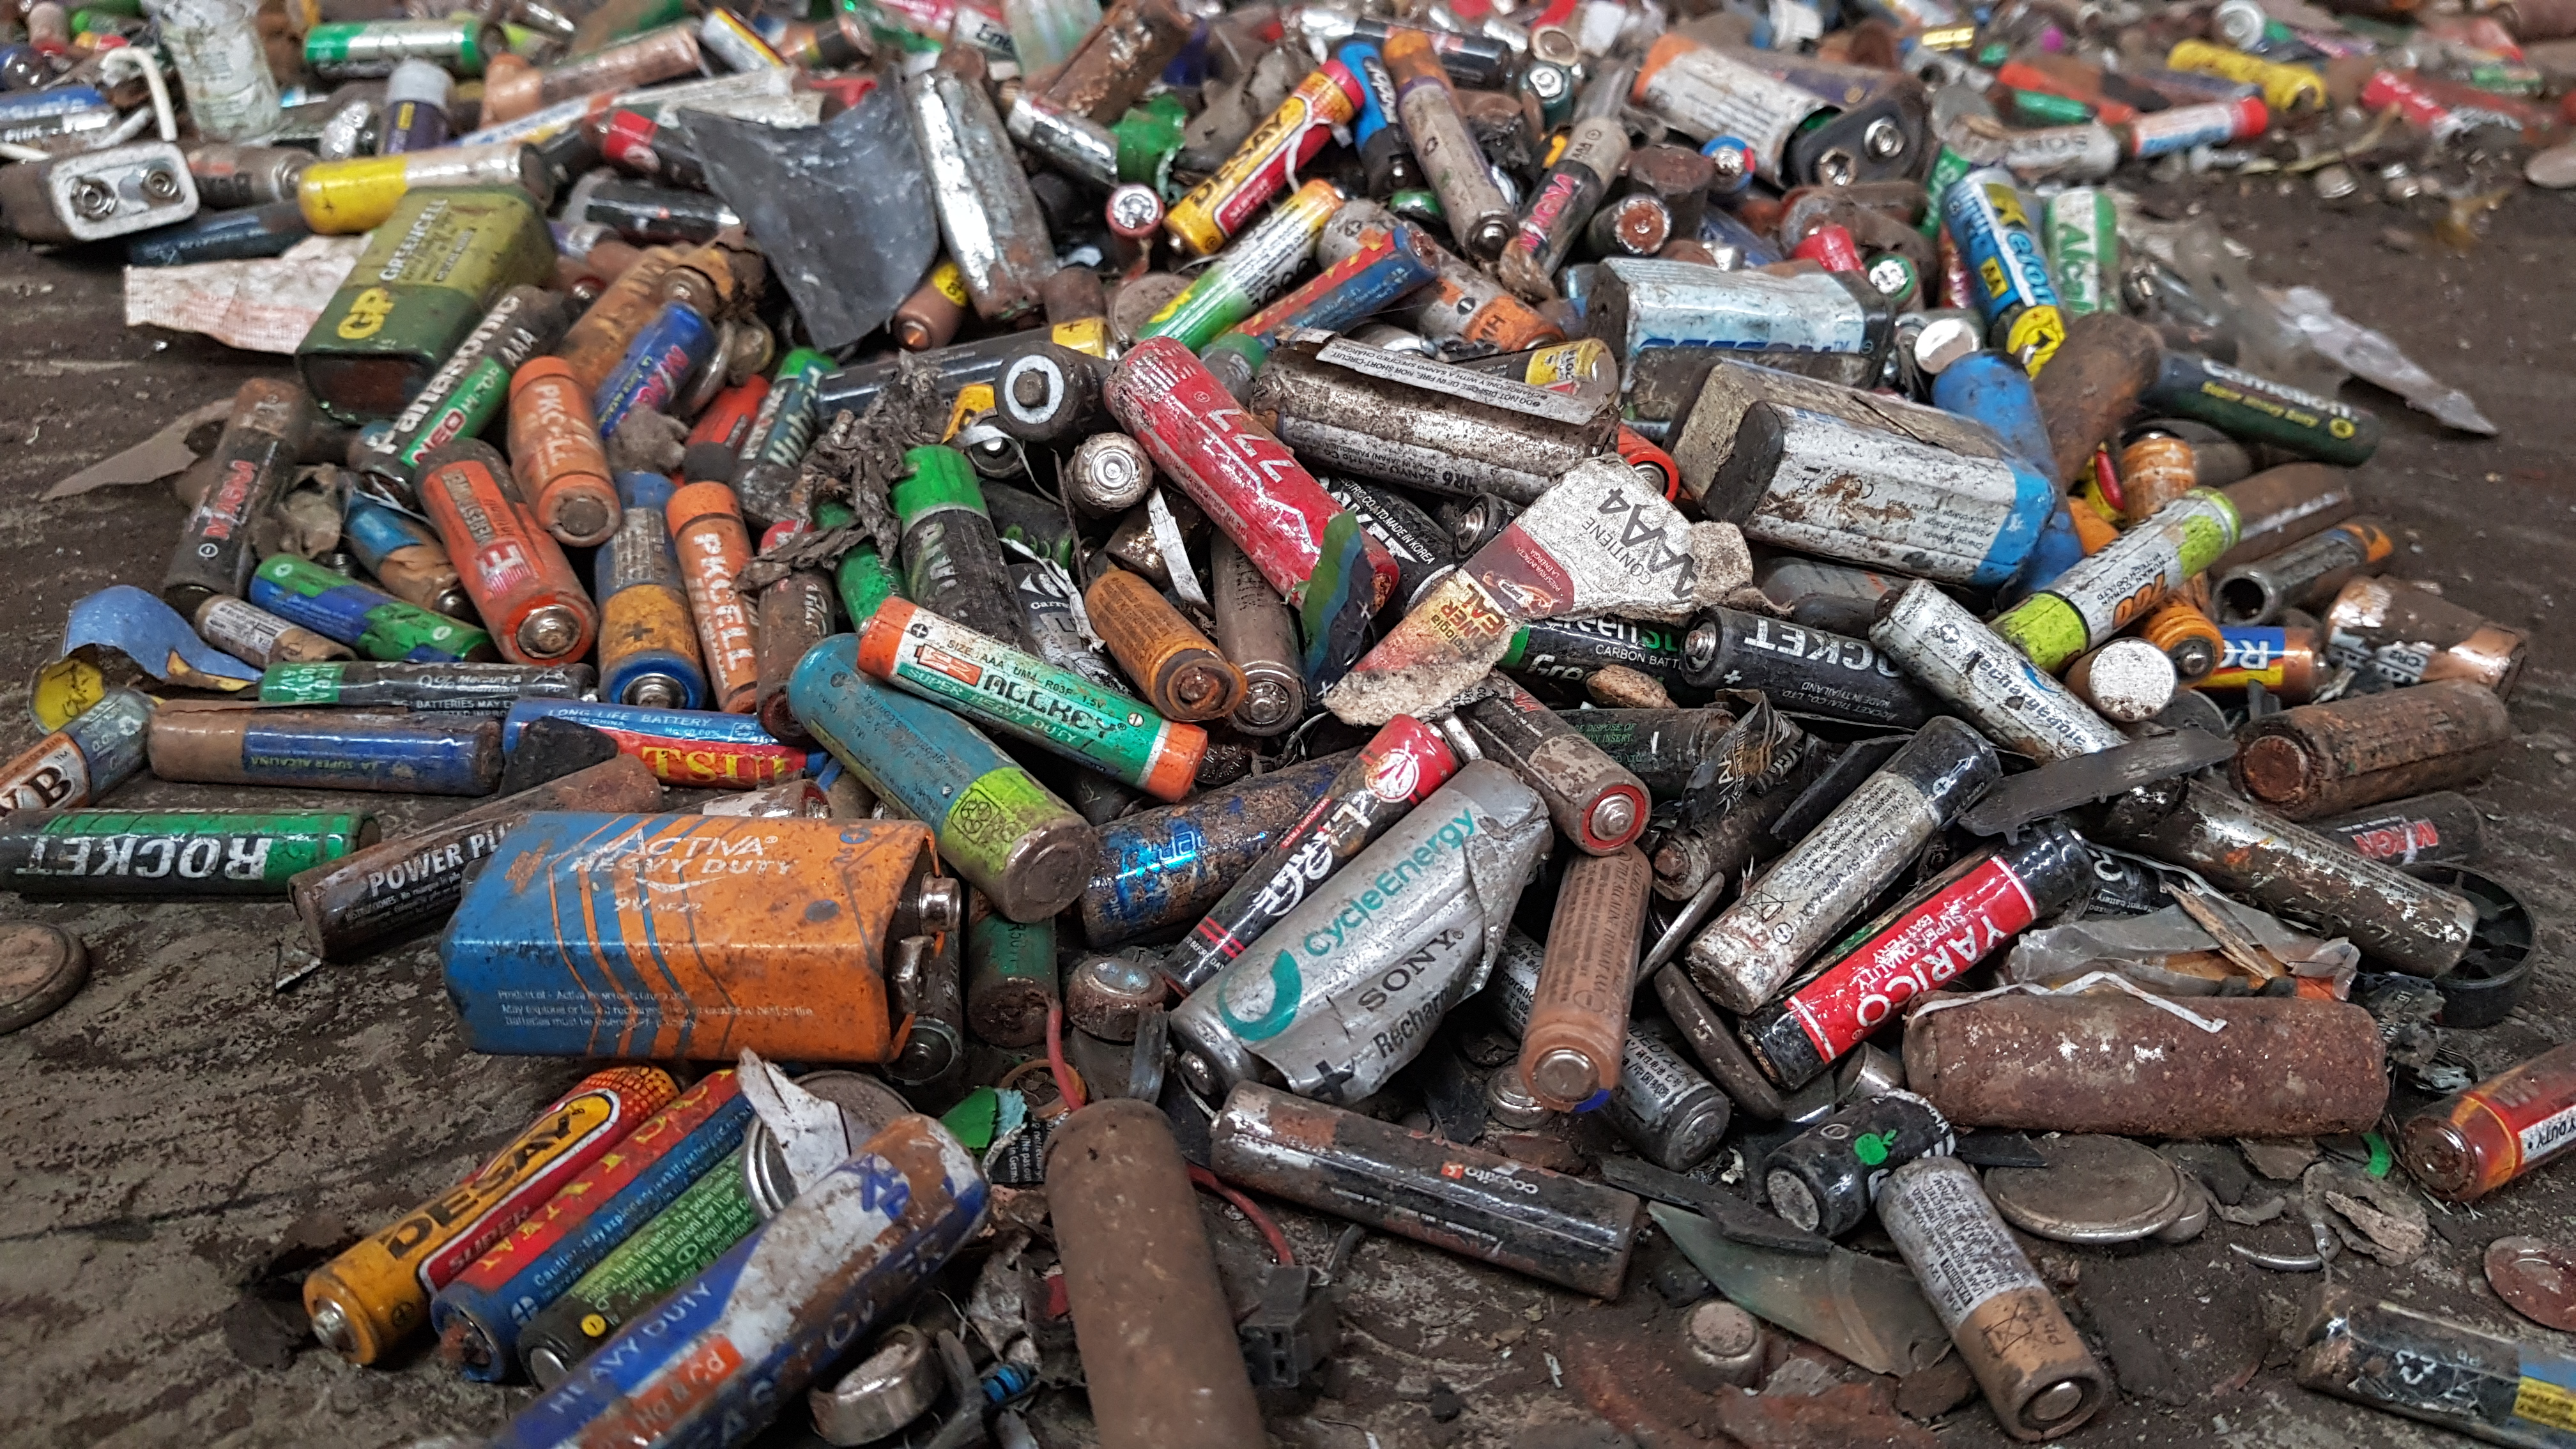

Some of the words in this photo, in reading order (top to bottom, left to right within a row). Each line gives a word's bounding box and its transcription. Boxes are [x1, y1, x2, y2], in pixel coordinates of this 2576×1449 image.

[1394, 366, 1414, 378] NOR
[1416, 362, 1446, 376] SANYO
[1455, 372, 1479, 384] WITH
[1499, 392, 1519, 403] NOT
[1409, 539, 1435, 565] KOREA
[1581, 515, 1654, 587] CONTIENE
[1549, 568, 1560, 579] LA
[946, 639, 974, 657] SIZE
[979, 653, 1006, 670] AAA
[1011, 666, 1038, 683] UM4
[1594, 642, 1646, 664] CARBON
[1648, 653, 1683, 671] BATT
[906, 666, 964, 698] SUPER
[1031, 716, 1078, 744] DUTY
[1800, 681, 1851, 700] THAILAND
[548, 709, 590, 717] LONG
[598, 710, 631, 721] LIFE
[641, 713, 713, 727] BATTERY
[592, 718, 625, 727] CHINA
[1586, 723, 1622, 732] DISPOSE
[589, 827, 767, 857] ACTIVA
[1280, 826, 1302, 848] FREE
[13, 835, 272, 880] ROCKET
[366, 841, 464, 897] POWER
[701, 859, 804, 874] DUTY
[1299, 806, 1473, 960] CycleEnergy
[613, 897, 651, 911] 9V
[1867, 912, 1936, 967] BATTERY
[1354, 926, 1461, 1016] SONY
[1857, 937, 1920, 989] QUALITY
[1857, 915, 2007, 1027] YARICO
[381, 1113, 576, 1261] DESAY
[548, 1335, 641, 1416] HEAVY
[643, 1280, 713, 1339] DUTY
